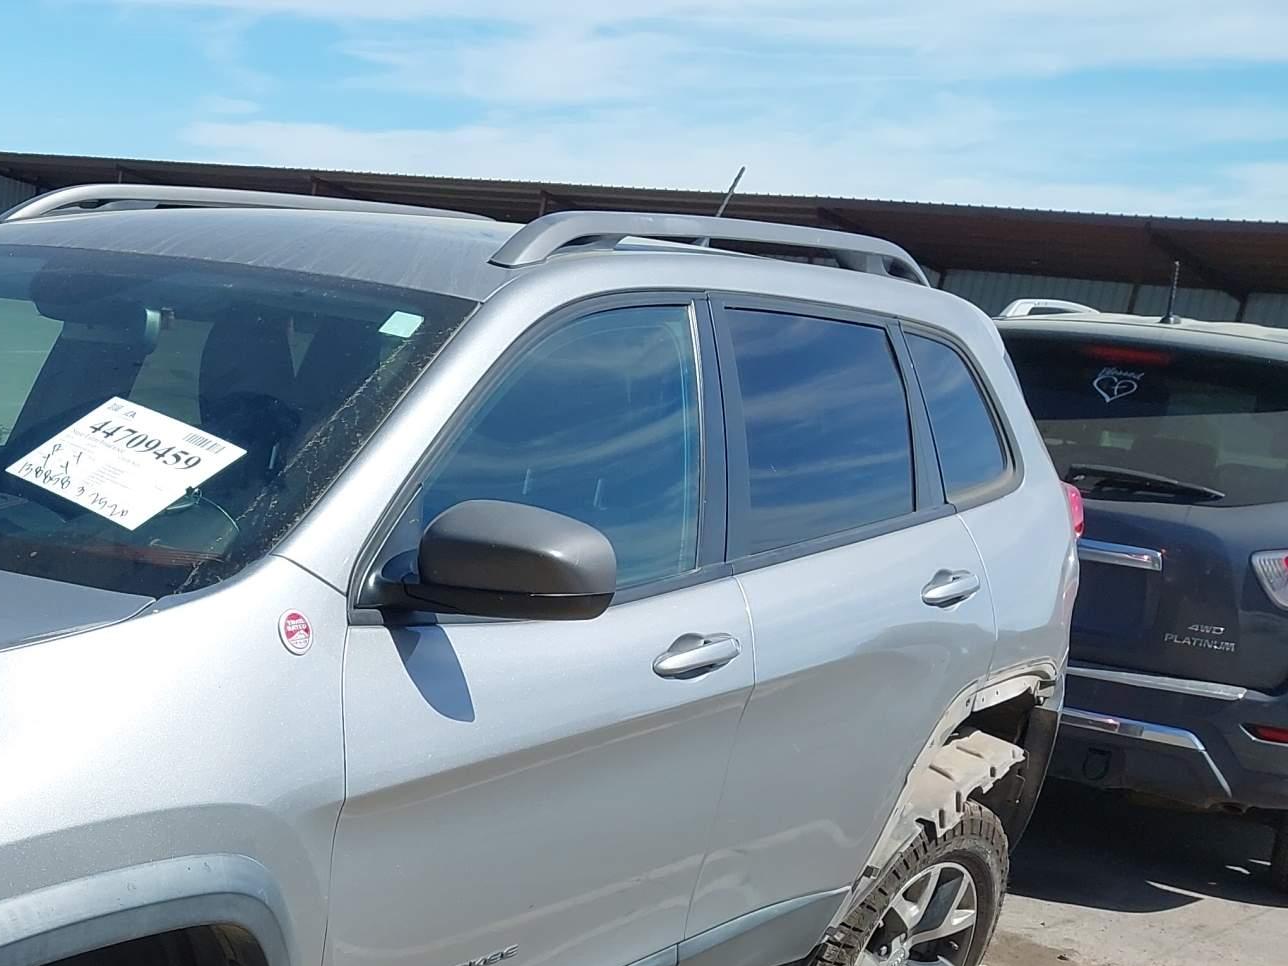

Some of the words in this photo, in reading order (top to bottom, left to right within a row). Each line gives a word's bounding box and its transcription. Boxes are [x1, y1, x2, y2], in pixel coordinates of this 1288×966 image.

[90, 420, 202, 470] 44709459
[1187, 624, 1226, 635] 4WD
[1164, 633, 1236, 652] PLATINUM
